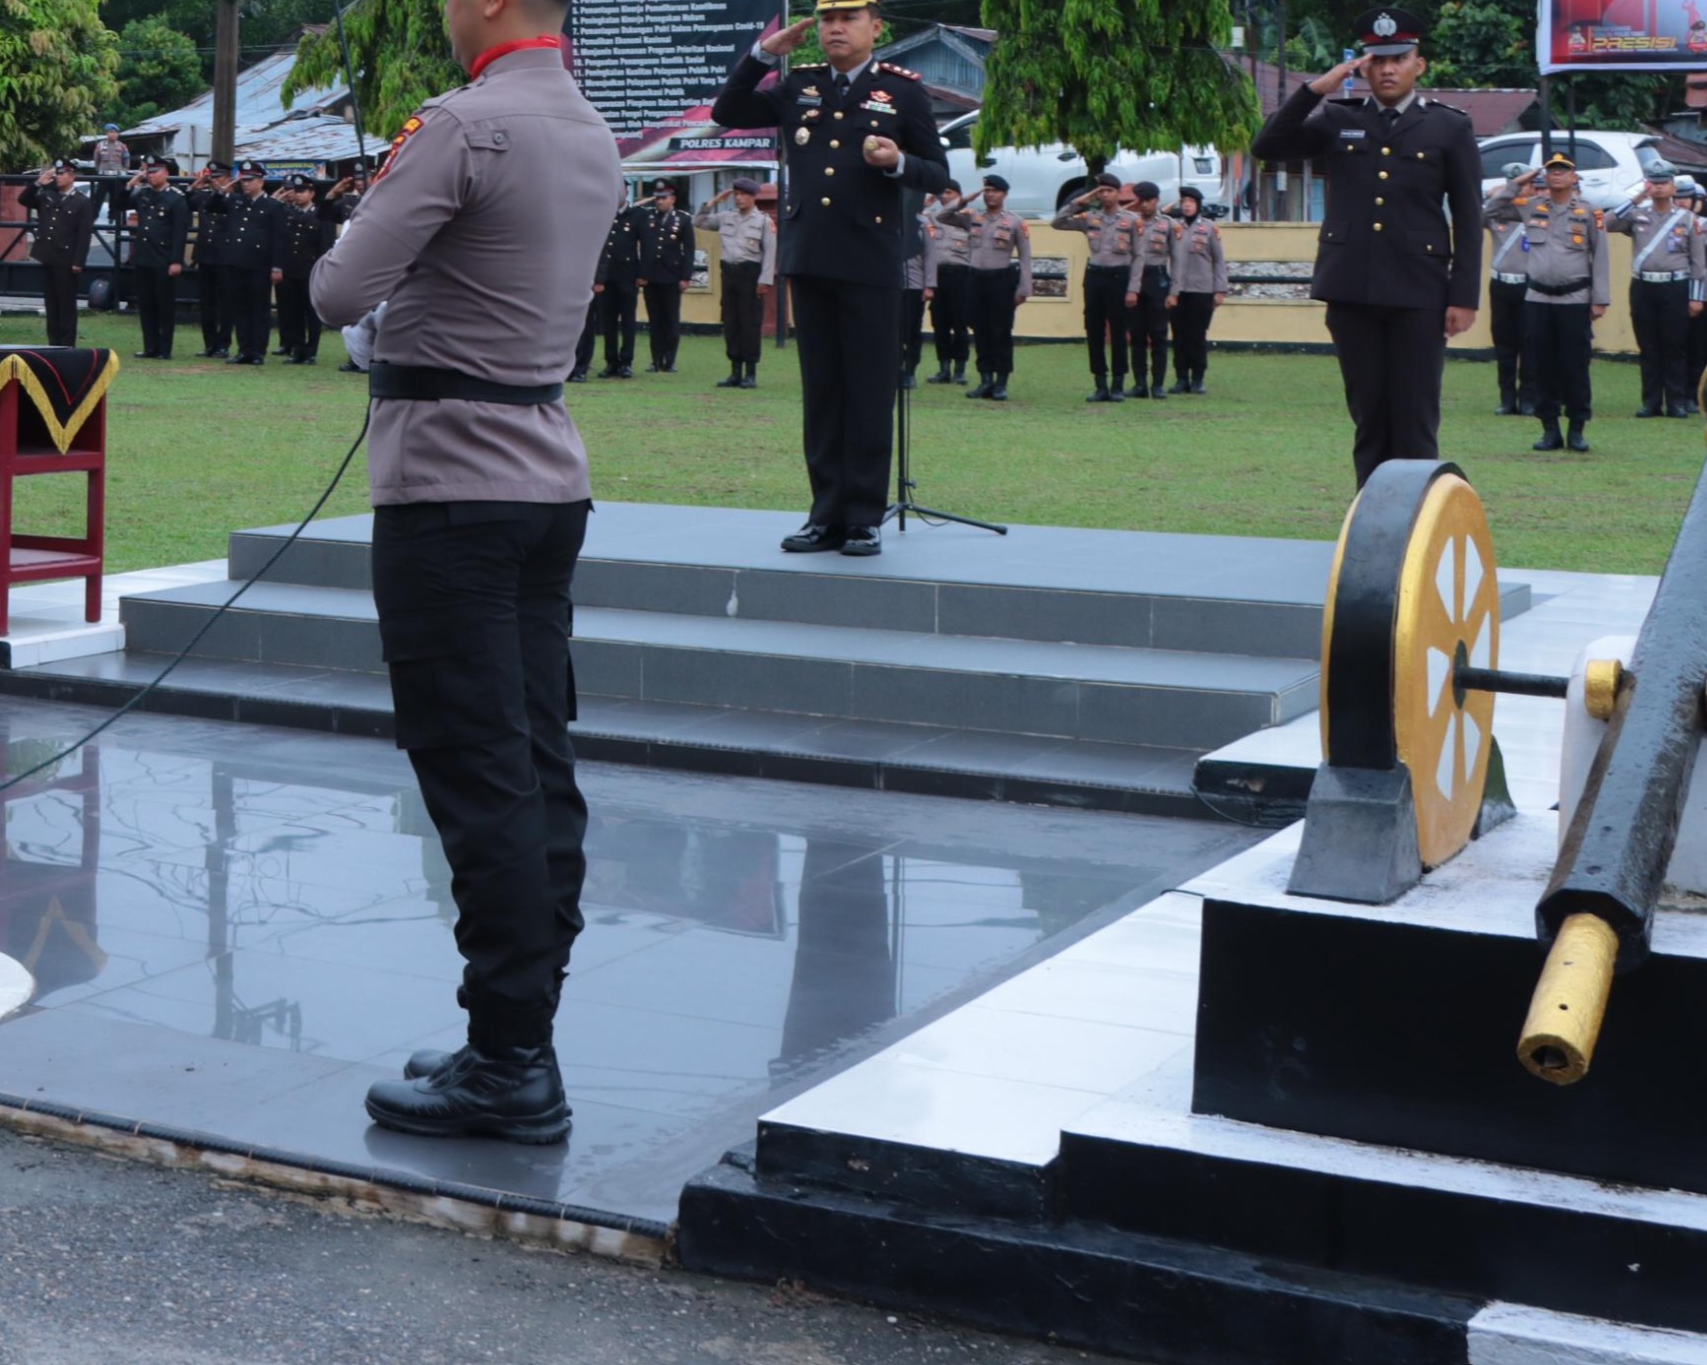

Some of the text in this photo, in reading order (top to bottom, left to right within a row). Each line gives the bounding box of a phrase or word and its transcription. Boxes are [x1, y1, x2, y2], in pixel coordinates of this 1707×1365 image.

[1592, 36, 1677, 49] PRESISI
[680, 138, 770, 149] POLRES KAMPAR
